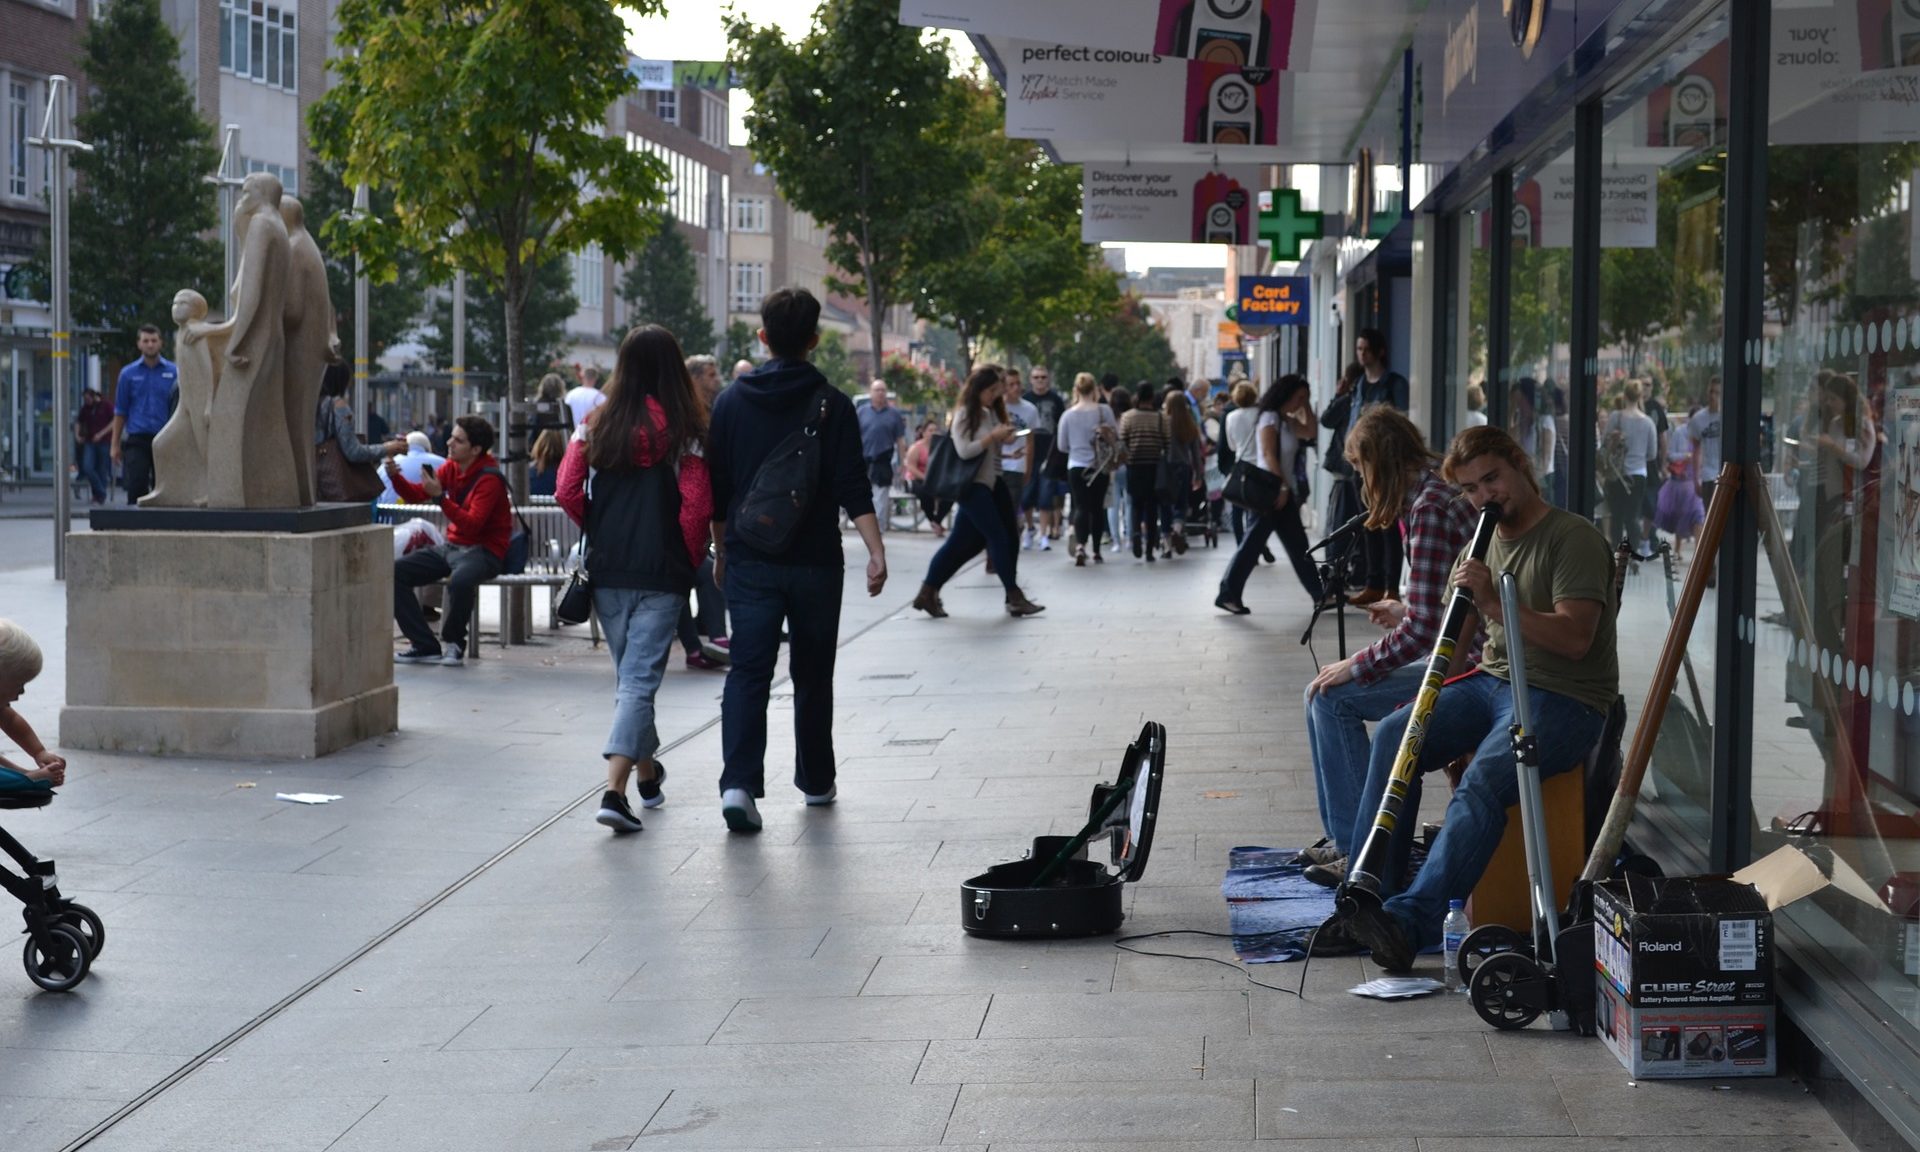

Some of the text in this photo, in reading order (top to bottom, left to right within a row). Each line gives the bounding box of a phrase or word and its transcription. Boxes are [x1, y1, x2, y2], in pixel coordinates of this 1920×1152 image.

[1022, 44, 1090, 63] perfect
[1046, 74, 1082, 87] Match
[1085, 75, 1118, 88] Made
[1062, 87, 1105, 101] Service
[1092, 171, 1173, 186] Discover your
[1092, 186, 1178, 198] perfect colours
[1253, 284, 1290, 299] Card
[1242, 298, 1301, 315] Factory
[1639, 941, 1682, 952] Roland
[1640, 982, 1692, 993] CUBE
[1692, 980, 1737, 994] Street
[1640, 996, 1662, 1004] Battery
[1709, 995, 1736, 1003] Amplifier
